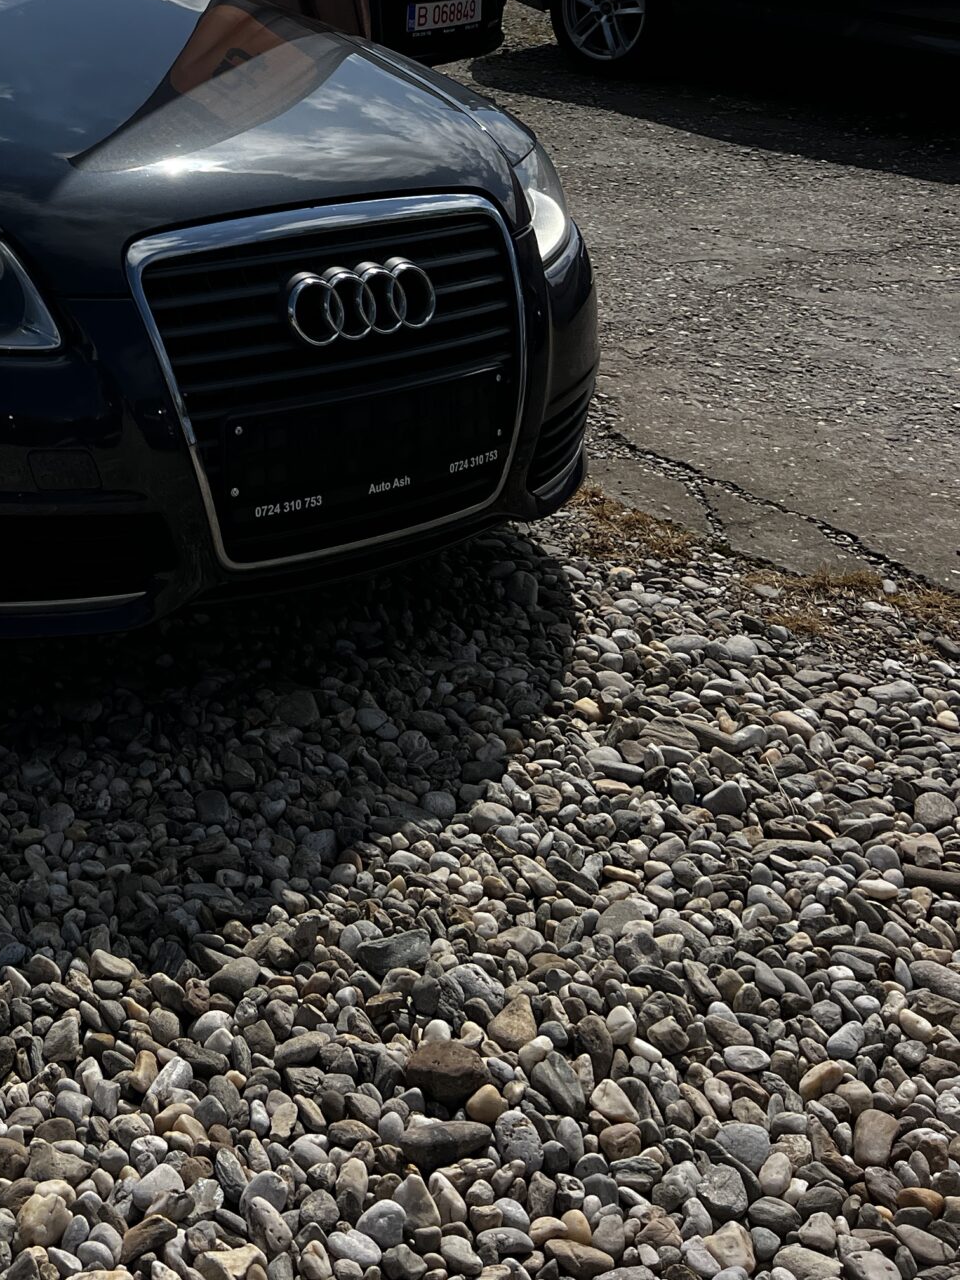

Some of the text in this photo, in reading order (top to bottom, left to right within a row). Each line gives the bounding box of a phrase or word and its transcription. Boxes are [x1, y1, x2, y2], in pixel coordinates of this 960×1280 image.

[417, 6, 428, 26] B
[432, 0, 476, 25] 068849
[449, 449, 498, 474] 0724 310 753
[368, 475, 411, 495] Auto Ash
[255, 495, 322, 518] 0724 310 753
